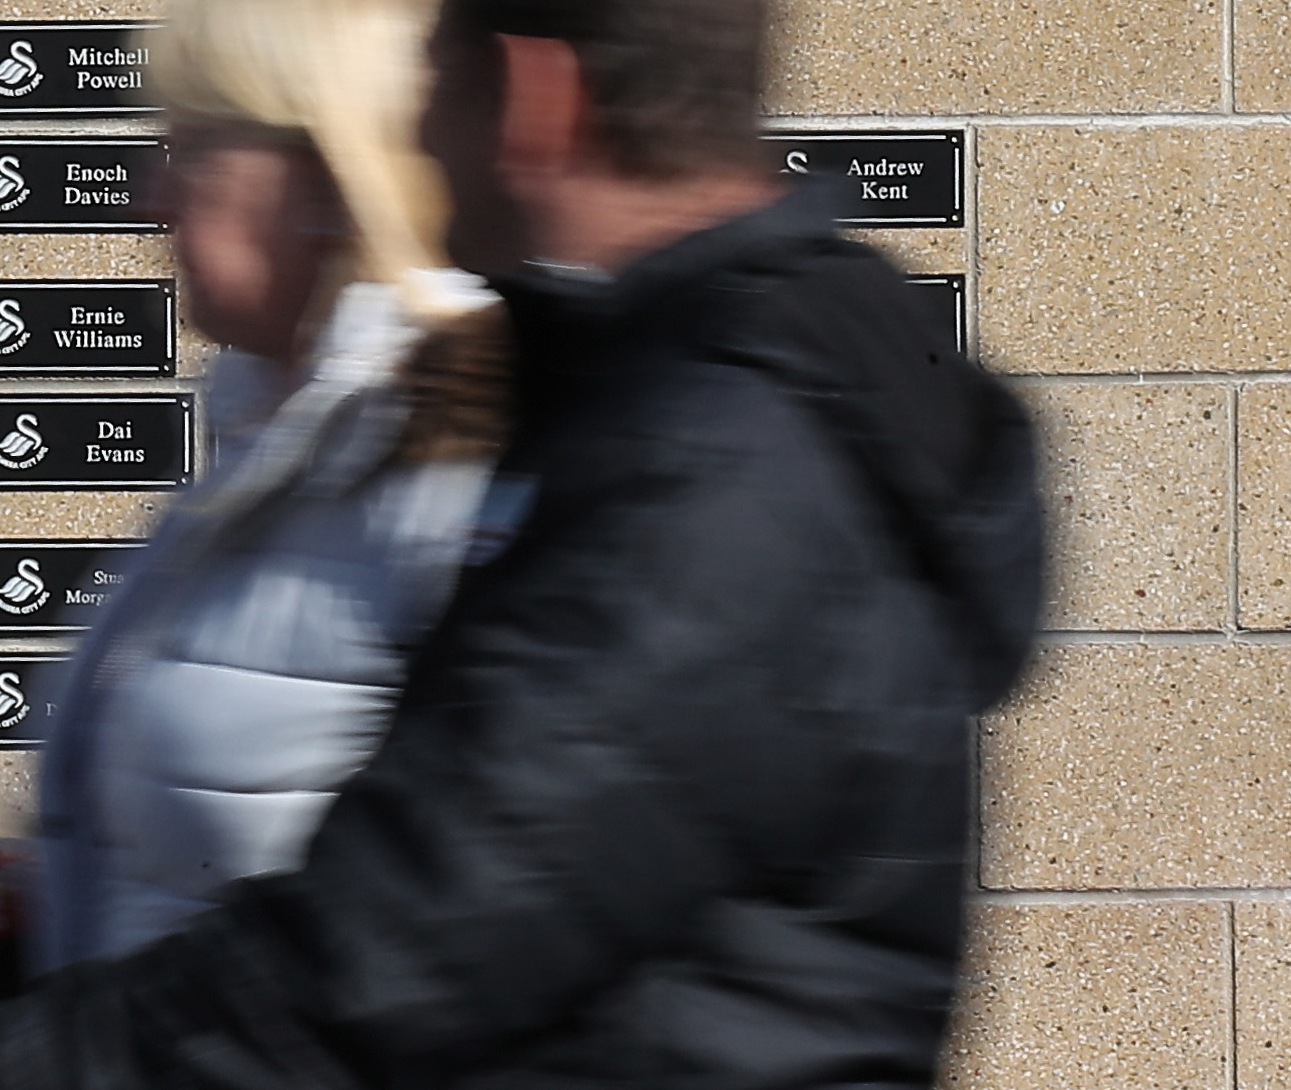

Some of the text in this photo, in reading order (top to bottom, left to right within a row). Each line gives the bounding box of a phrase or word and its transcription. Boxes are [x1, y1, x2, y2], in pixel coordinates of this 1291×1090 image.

[68, 47, 150, 66] Mitchell
[76, 71, 143, 89] Powell
[66, 163, 128, 182] Enoch
[846, 158, 924, 176] Andrew
[64, 186, 130, 205] Davies
[861, 181, 909, 200] Kent
[70, 306, 125, 325] Ernie
[53, 329, 143, 349] Williams
[97, 421, 132, 440] Dai
[86, 444, 145, 463] Evans
